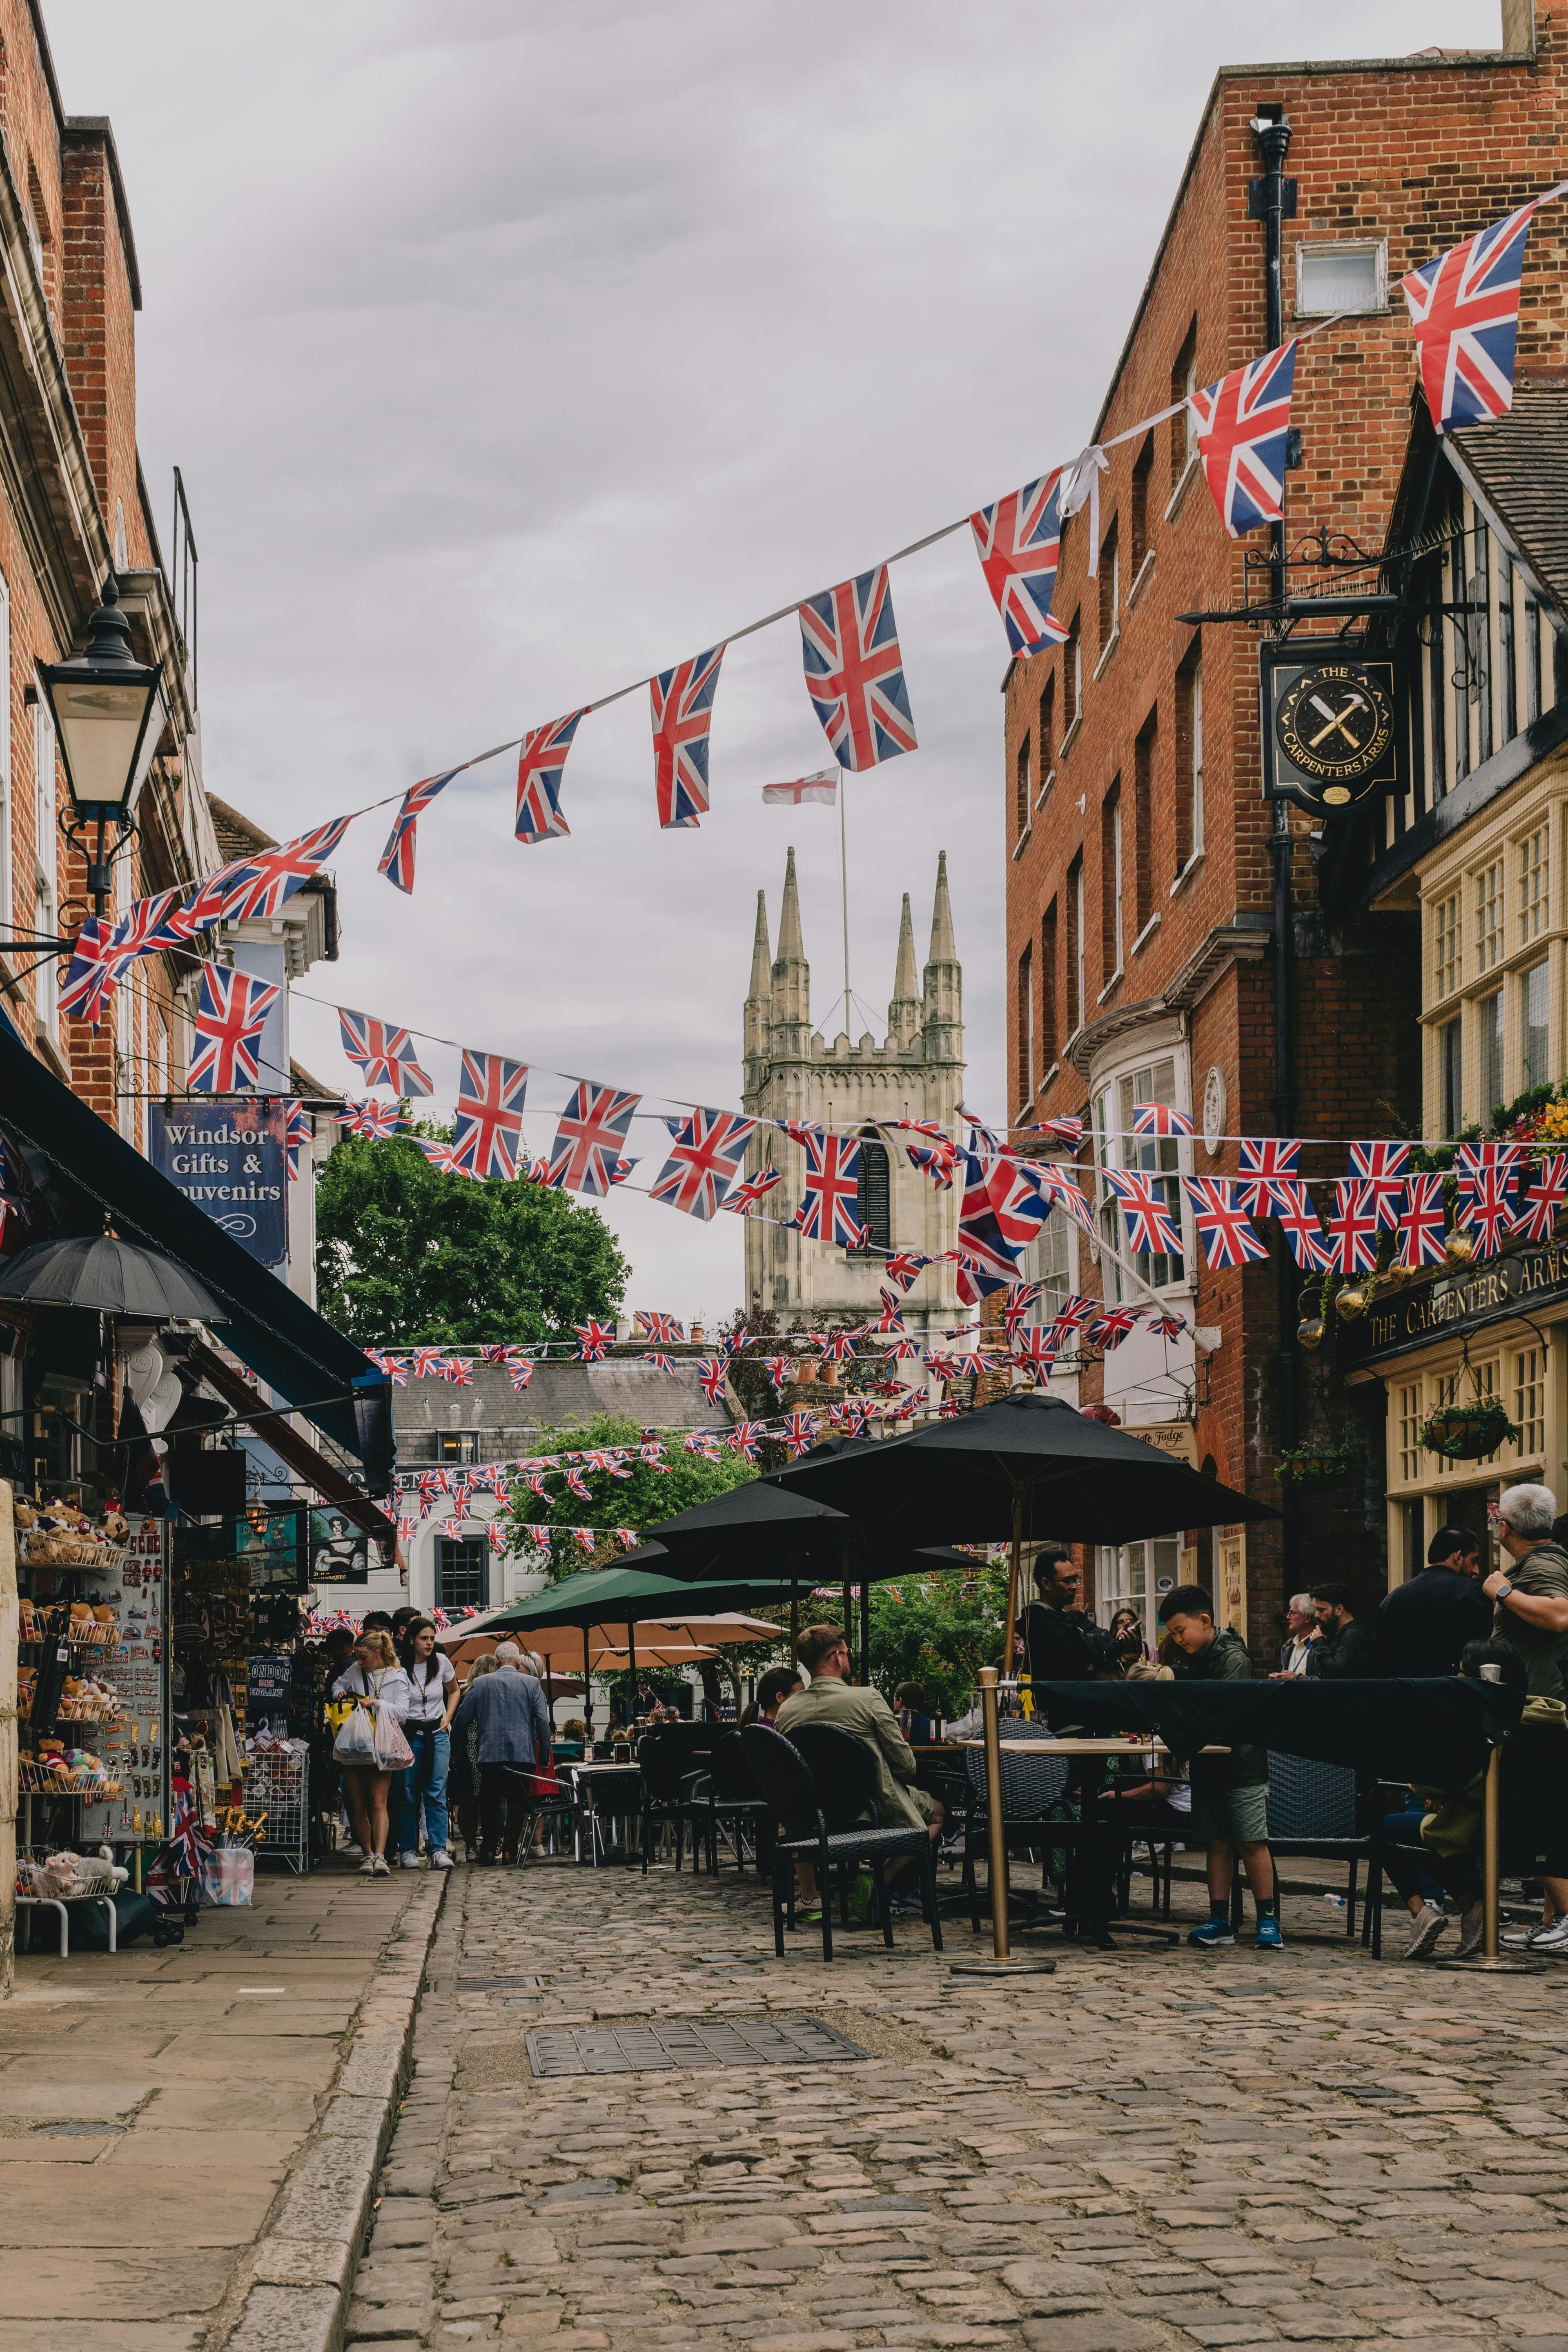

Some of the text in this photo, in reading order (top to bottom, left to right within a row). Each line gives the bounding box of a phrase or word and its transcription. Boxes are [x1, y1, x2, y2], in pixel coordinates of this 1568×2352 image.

[1318, 667, 1348, 678] THE
[1283, 728, 1389, 777] CARPENTERS ARMS
[164, 1124, 269, 1145] Windsor
[172, 1153, 262, 1174] Gifts &
[177, 1180, 281, 1201] ouvenirs
[1370, 1245, 1568, 1347] THE CARPENTERS ARMS
[1154, 1429, 1185, 1448] Fudge
[250, 1687, 283, 1697] ENGLAND
